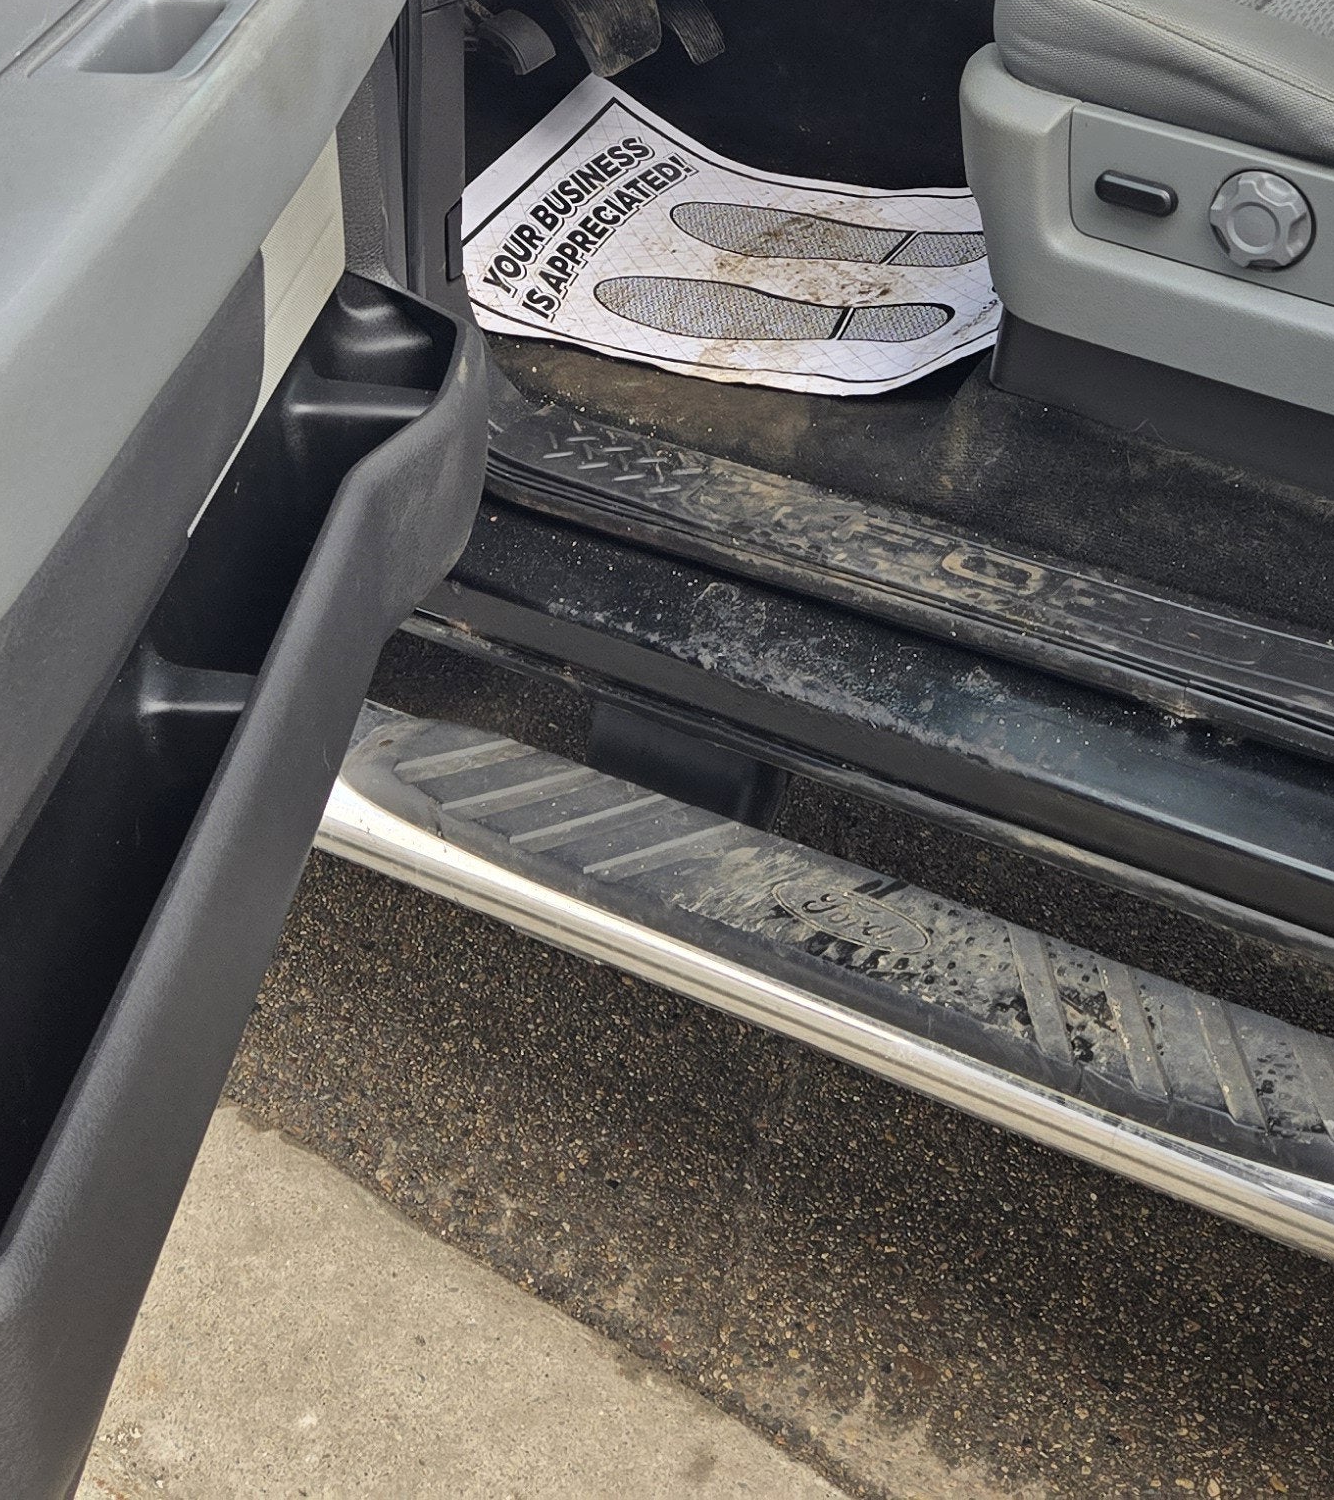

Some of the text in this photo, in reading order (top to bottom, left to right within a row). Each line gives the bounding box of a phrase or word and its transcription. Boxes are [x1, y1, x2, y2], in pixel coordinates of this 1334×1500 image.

[482, 136, 654, 297] YOUR BUSINESS
[521, 154, 696, 322] IS APPRECIATED!
